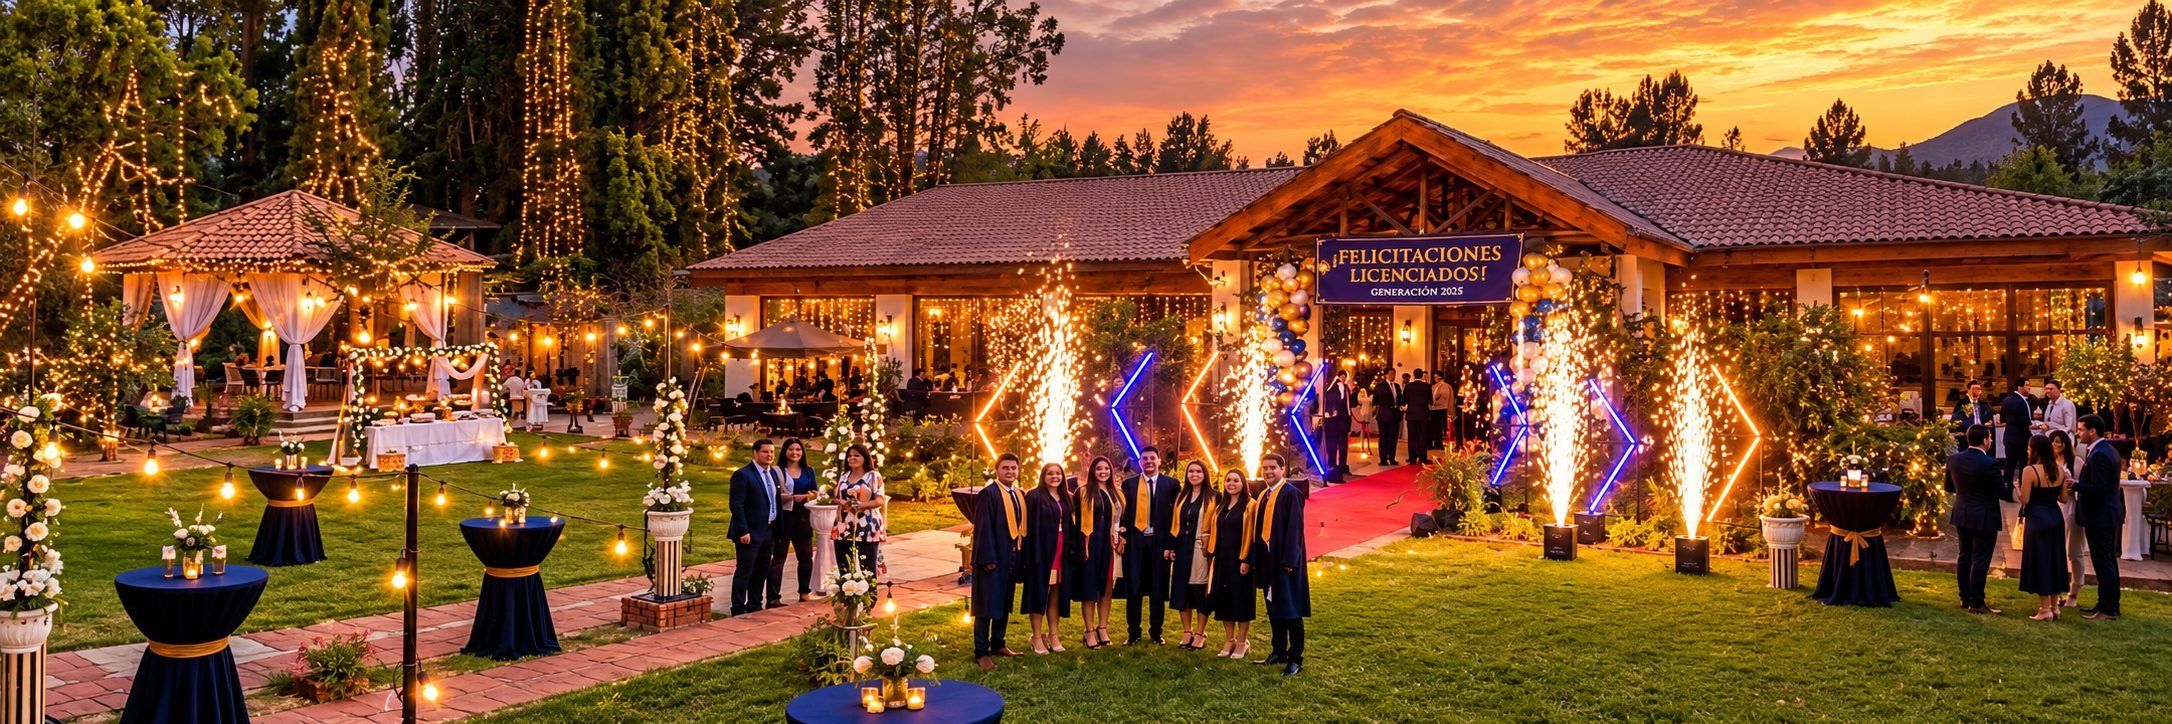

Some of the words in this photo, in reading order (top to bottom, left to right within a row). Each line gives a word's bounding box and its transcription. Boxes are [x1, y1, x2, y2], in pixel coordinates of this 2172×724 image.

[1332, 245, 1502, 267] ¡FELICITACIONES
[1350, 266, 1487, 283] LICENCIADOS!
[1370, 285, 1438, 296] GENERACIÓN
[1440, 286, 1463, 296] 2025
